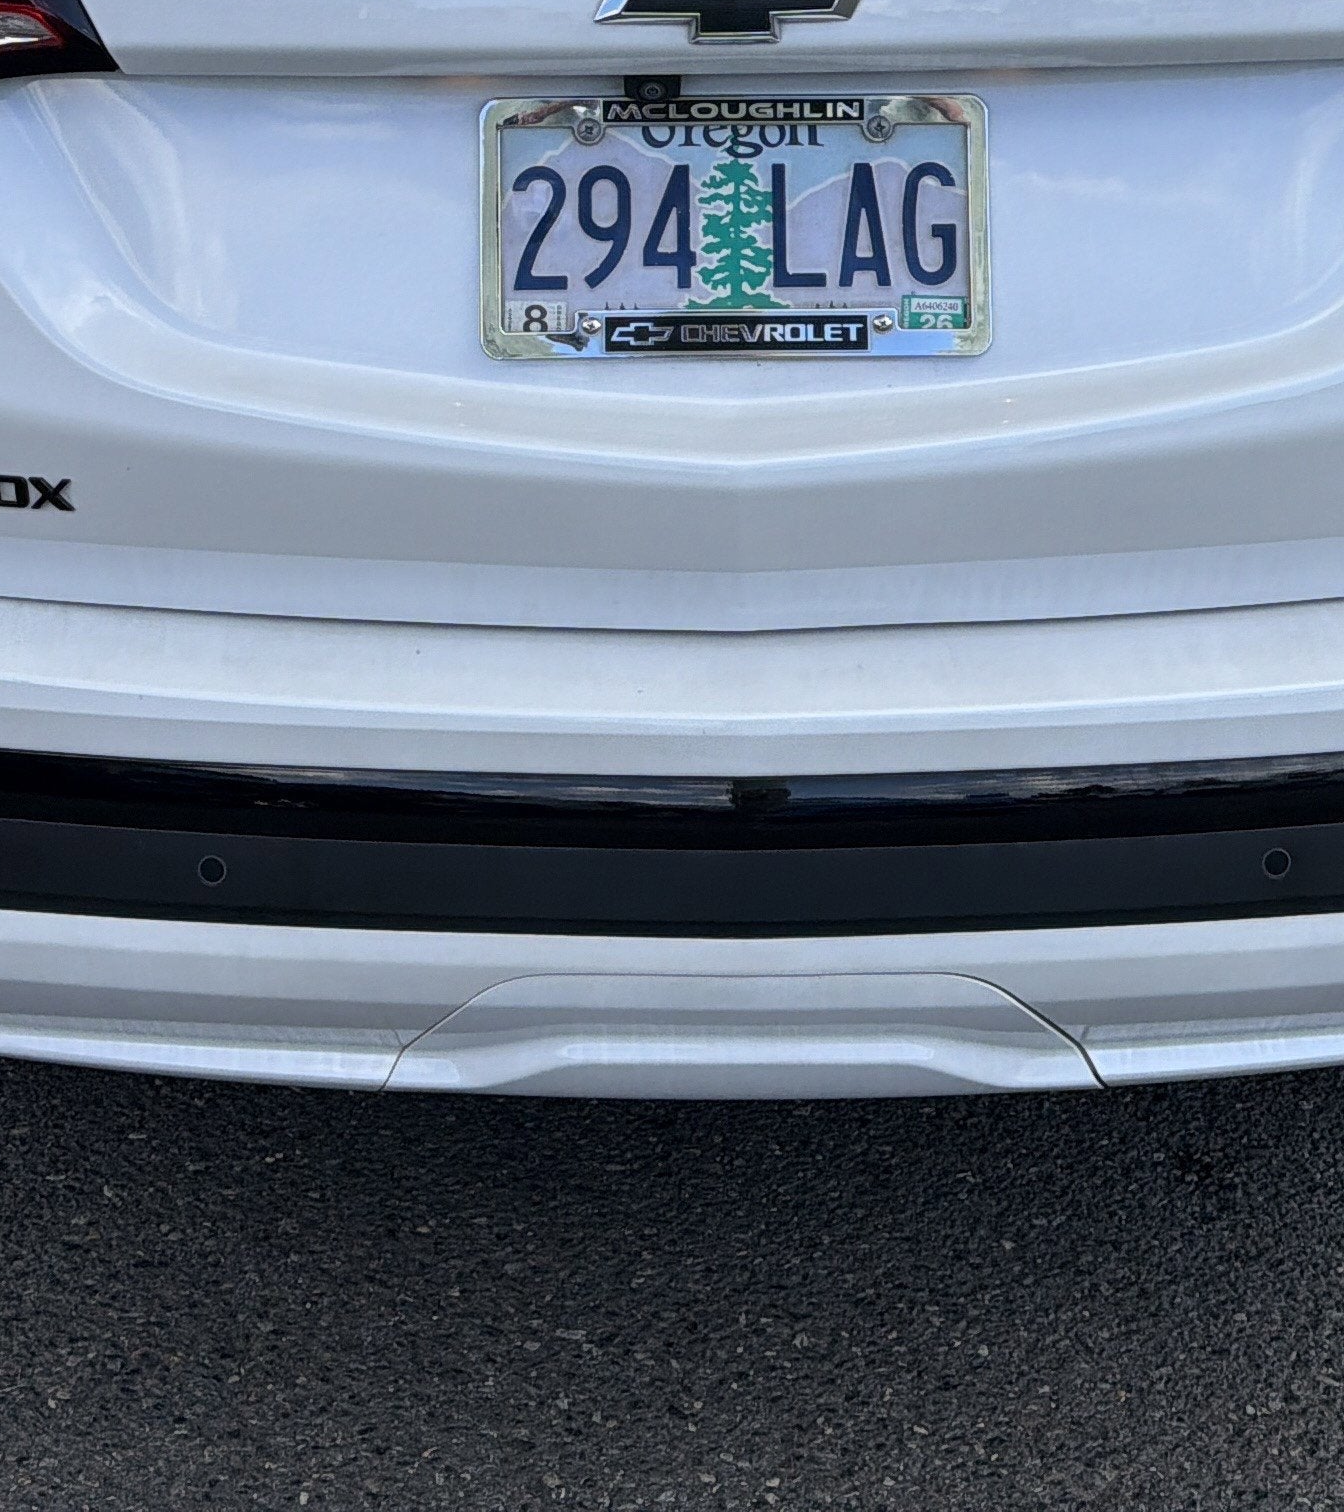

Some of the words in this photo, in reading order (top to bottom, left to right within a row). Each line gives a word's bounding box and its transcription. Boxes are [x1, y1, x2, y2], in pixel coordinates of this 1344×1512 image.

[607, 102, 860, 120] MCLOUGHLIN
[511, 164, 697, 291] 294
[771, 162, 957, 287] LAG
[523, 304, 548, 332] 8
[919, 314, 954, 329] 26
[680, 324, 864, 342] CHEVROLET
